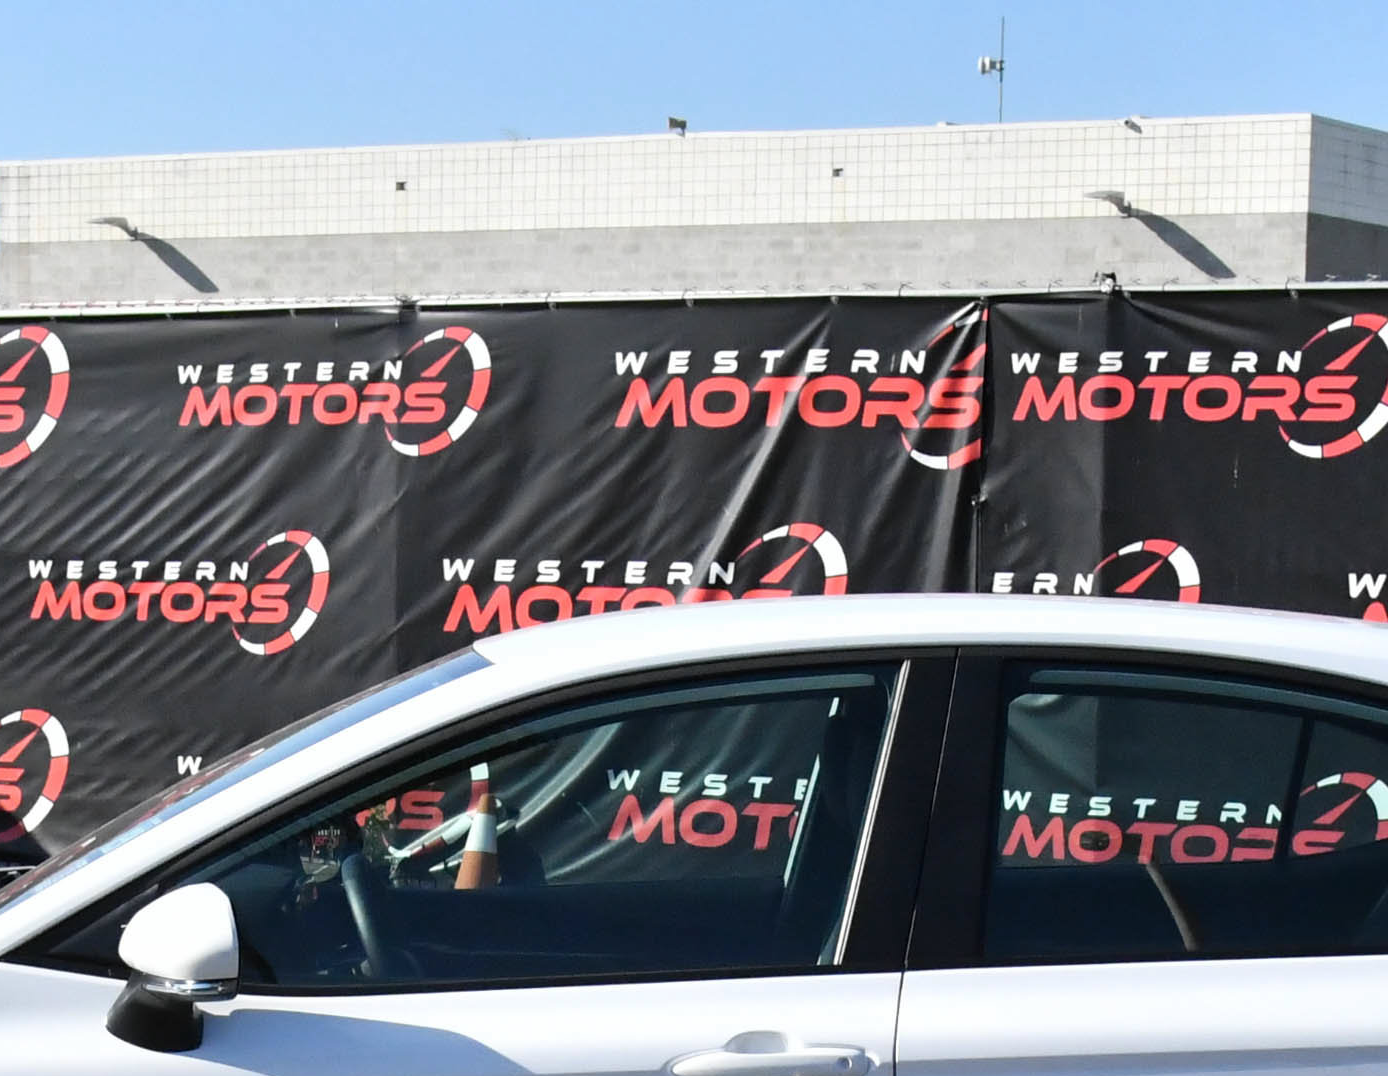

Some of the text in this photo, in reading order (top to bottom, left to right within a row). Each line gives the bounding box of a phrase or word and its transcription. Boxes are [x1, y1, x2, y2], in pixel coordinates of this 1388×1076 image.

[177, 360, 402, 384] WESTERN
[615, 349, 925, 374] WESTERN
[1011, 350, 1302, 373] WESTERN
[178, 382, 447, 426] MOTORS
[615, 375, 984, 428] MOTORS
[1012, 375, 1358, 422] MOTORS
[28, 559, 249, 582] WESTERN
[443, 559, 735, 585] WESTERN
[30, 581, 290, 624] MOTORS
[607, 769, 809, 801] WESTE
